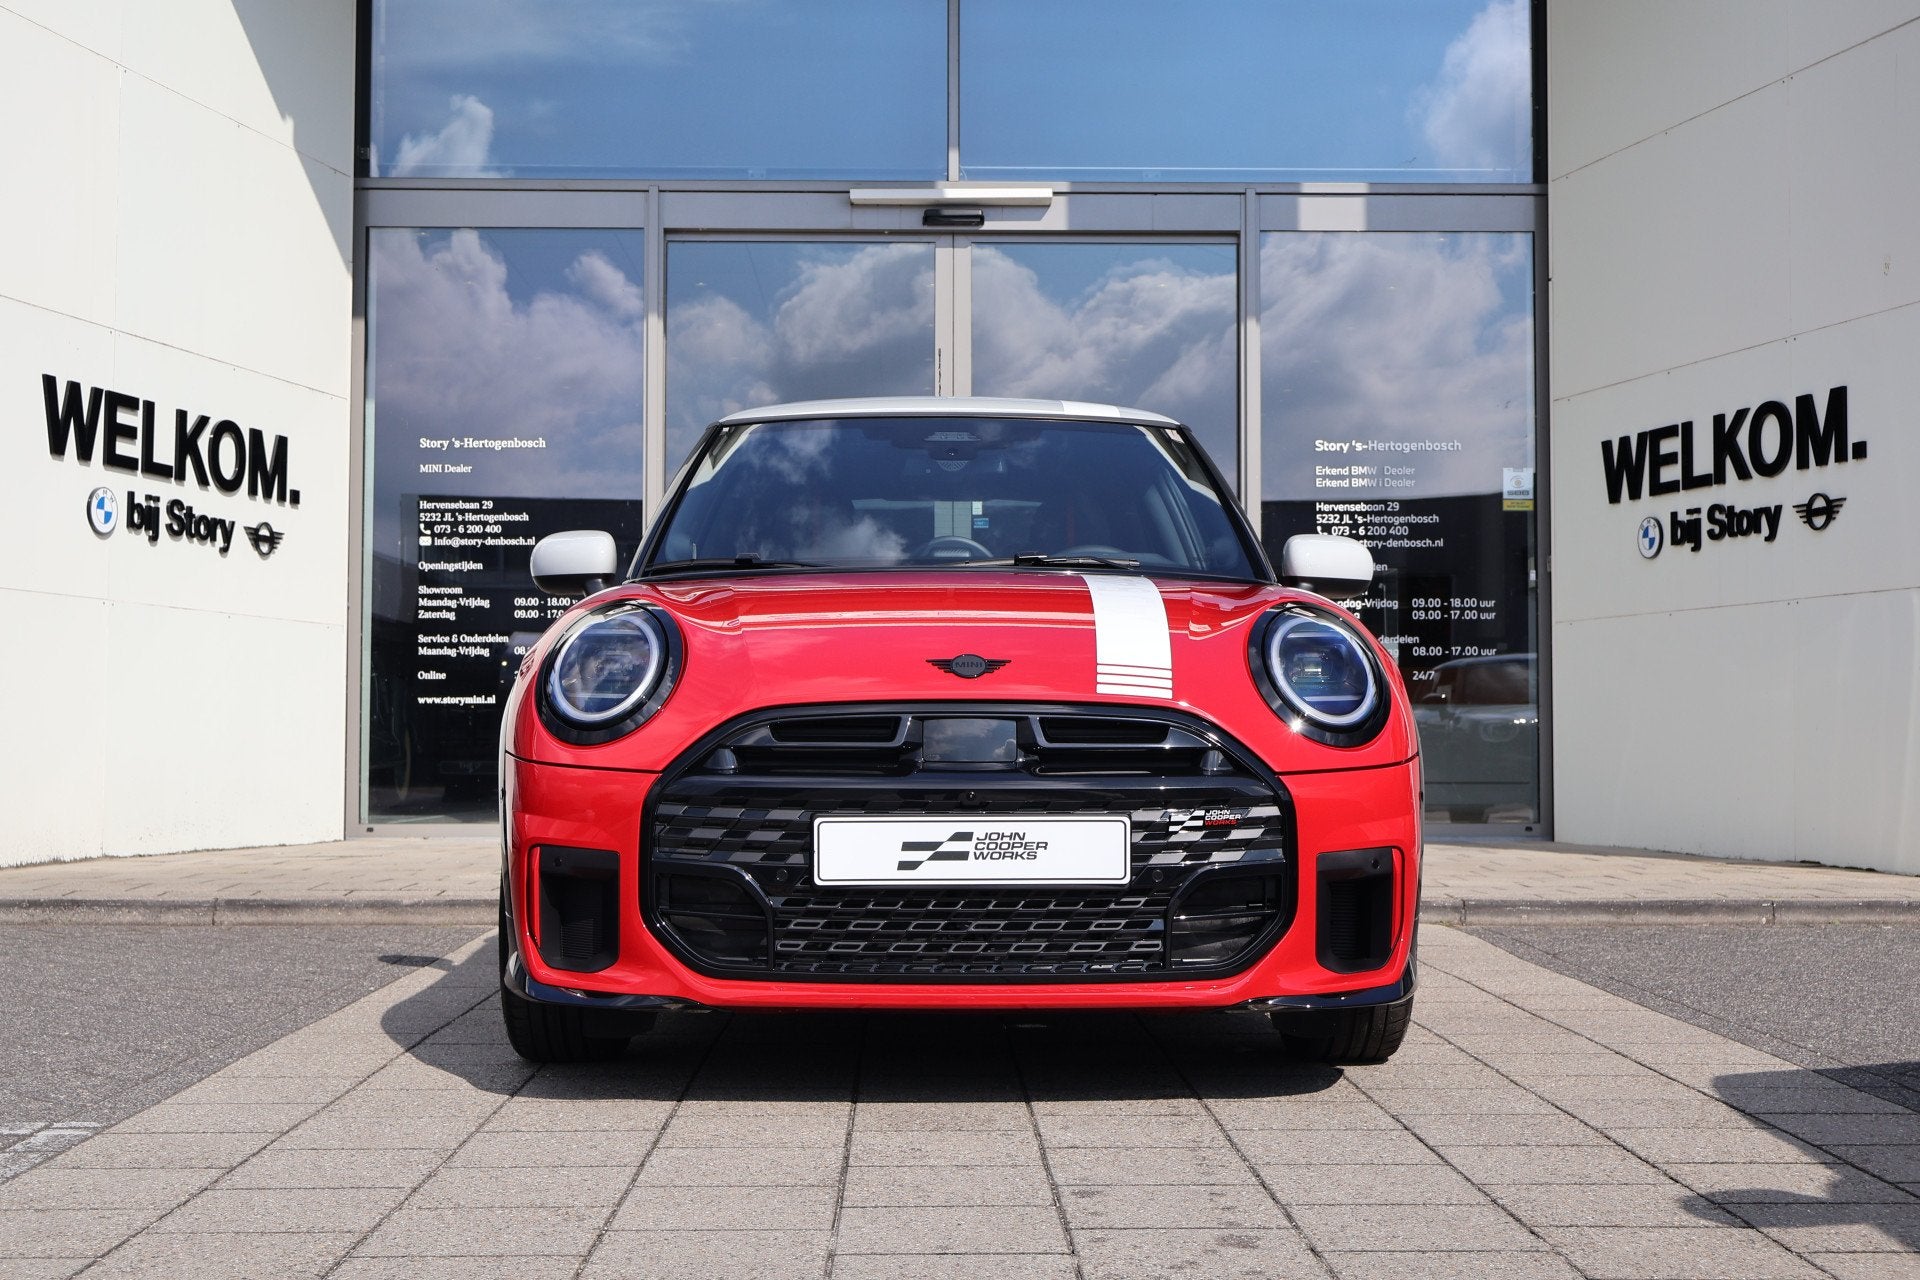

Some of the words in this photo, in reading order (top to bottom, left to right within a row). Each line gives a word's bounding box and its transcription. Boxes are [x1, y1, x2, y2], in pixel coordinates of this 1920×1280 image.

[42, 373, 300, 505] WELKOM.
[419, 438, 449, 450] Story
[1315, 440, 1350, 453] Story
[1601, 386, 1867, 504] WELKOM.
[419, 464, 442, 473] MINI
[444, 464, 472, 473] Dealer
[1316, 466, 1348, 475] Erkend
[1351, 466, 1377, 475] BMW
[1384, 466, 1415, 475] Dealer
[1316, 478, 1348, 487] Erkend
[1351, 478, 1377, 487] BMW
[1384, 478, 1415, 487] Dealer
[419, 501, 480, 509] Hervensebaan
[481, 501, 493, 509] 29
[1316, 502, 1385, 511] Hervensebaan
[1387, 502, 1400, 511] 29
[126, 491, 160, 542] bij
[165, 499, 235, 553] Story
[419, 513, 441, 522] 5232
[443, 513, 454, 522] JL
[1316, 514, 1340, 523] 5232
[1342, 514, 1353, 524] JL
[434, 525, 451, 533] 073
[458, 525, 465, 533] 6
[466, 525, 483, 533] 200
[483, 525, 502, 533] 400
[1331, 526, 1350, 535] 073
[1358, 526, 1365, 535] 6
[1367, 526, 1387, 535] 200
[1389, 526, 1409, 535] 400
[1670, 507, 1701, 552] bij
[1706, 504, 1782, 542] Story
[434, 537, 536, 548] info@story-denbosch.nl
[1360, 538, 1444, 549] tory-denbosch.nl
[418, 561, 483, 571] Openingstijden
[418, 586, 463, 595] Showroom
[418, 598, 490, 608] Maandag-Vrijdag
[514, 597, 539, 606] 09.00
[547, 597, 571, 606] 18.00
[1412, 598, 1441, 608] 09.00
[1450, 598, 1478, 608] 18.00
[1479, 600, 1496, 608] uur
[418, 610, 456, 620] Zaterdag
[514, 609, 539, 618] 09.00
[1412, 610, 1441, 619] 09.00
[418, 634, 450, 643] Service
[451, 634, 458, 643] &
[460, 634, 509, 643] Onderdelen
[1378, 635, 1419, 643] derdelen
[418, 646, 490, 657] Maandag-Vrijdag
[1413, 647, 1442, 656] 08.00
[1480, 648, 1497, 656] uur
[418, 671, 446, 680] Online
[1412, 671, 1435, 681] 24/7
[418, 695, 496, 706] www.storymini.nl
[976, 832, 1026, 841] JOHN
[974, 842, 1049, 850] COOPER
[973, 851, 1038, 860] WORKS
